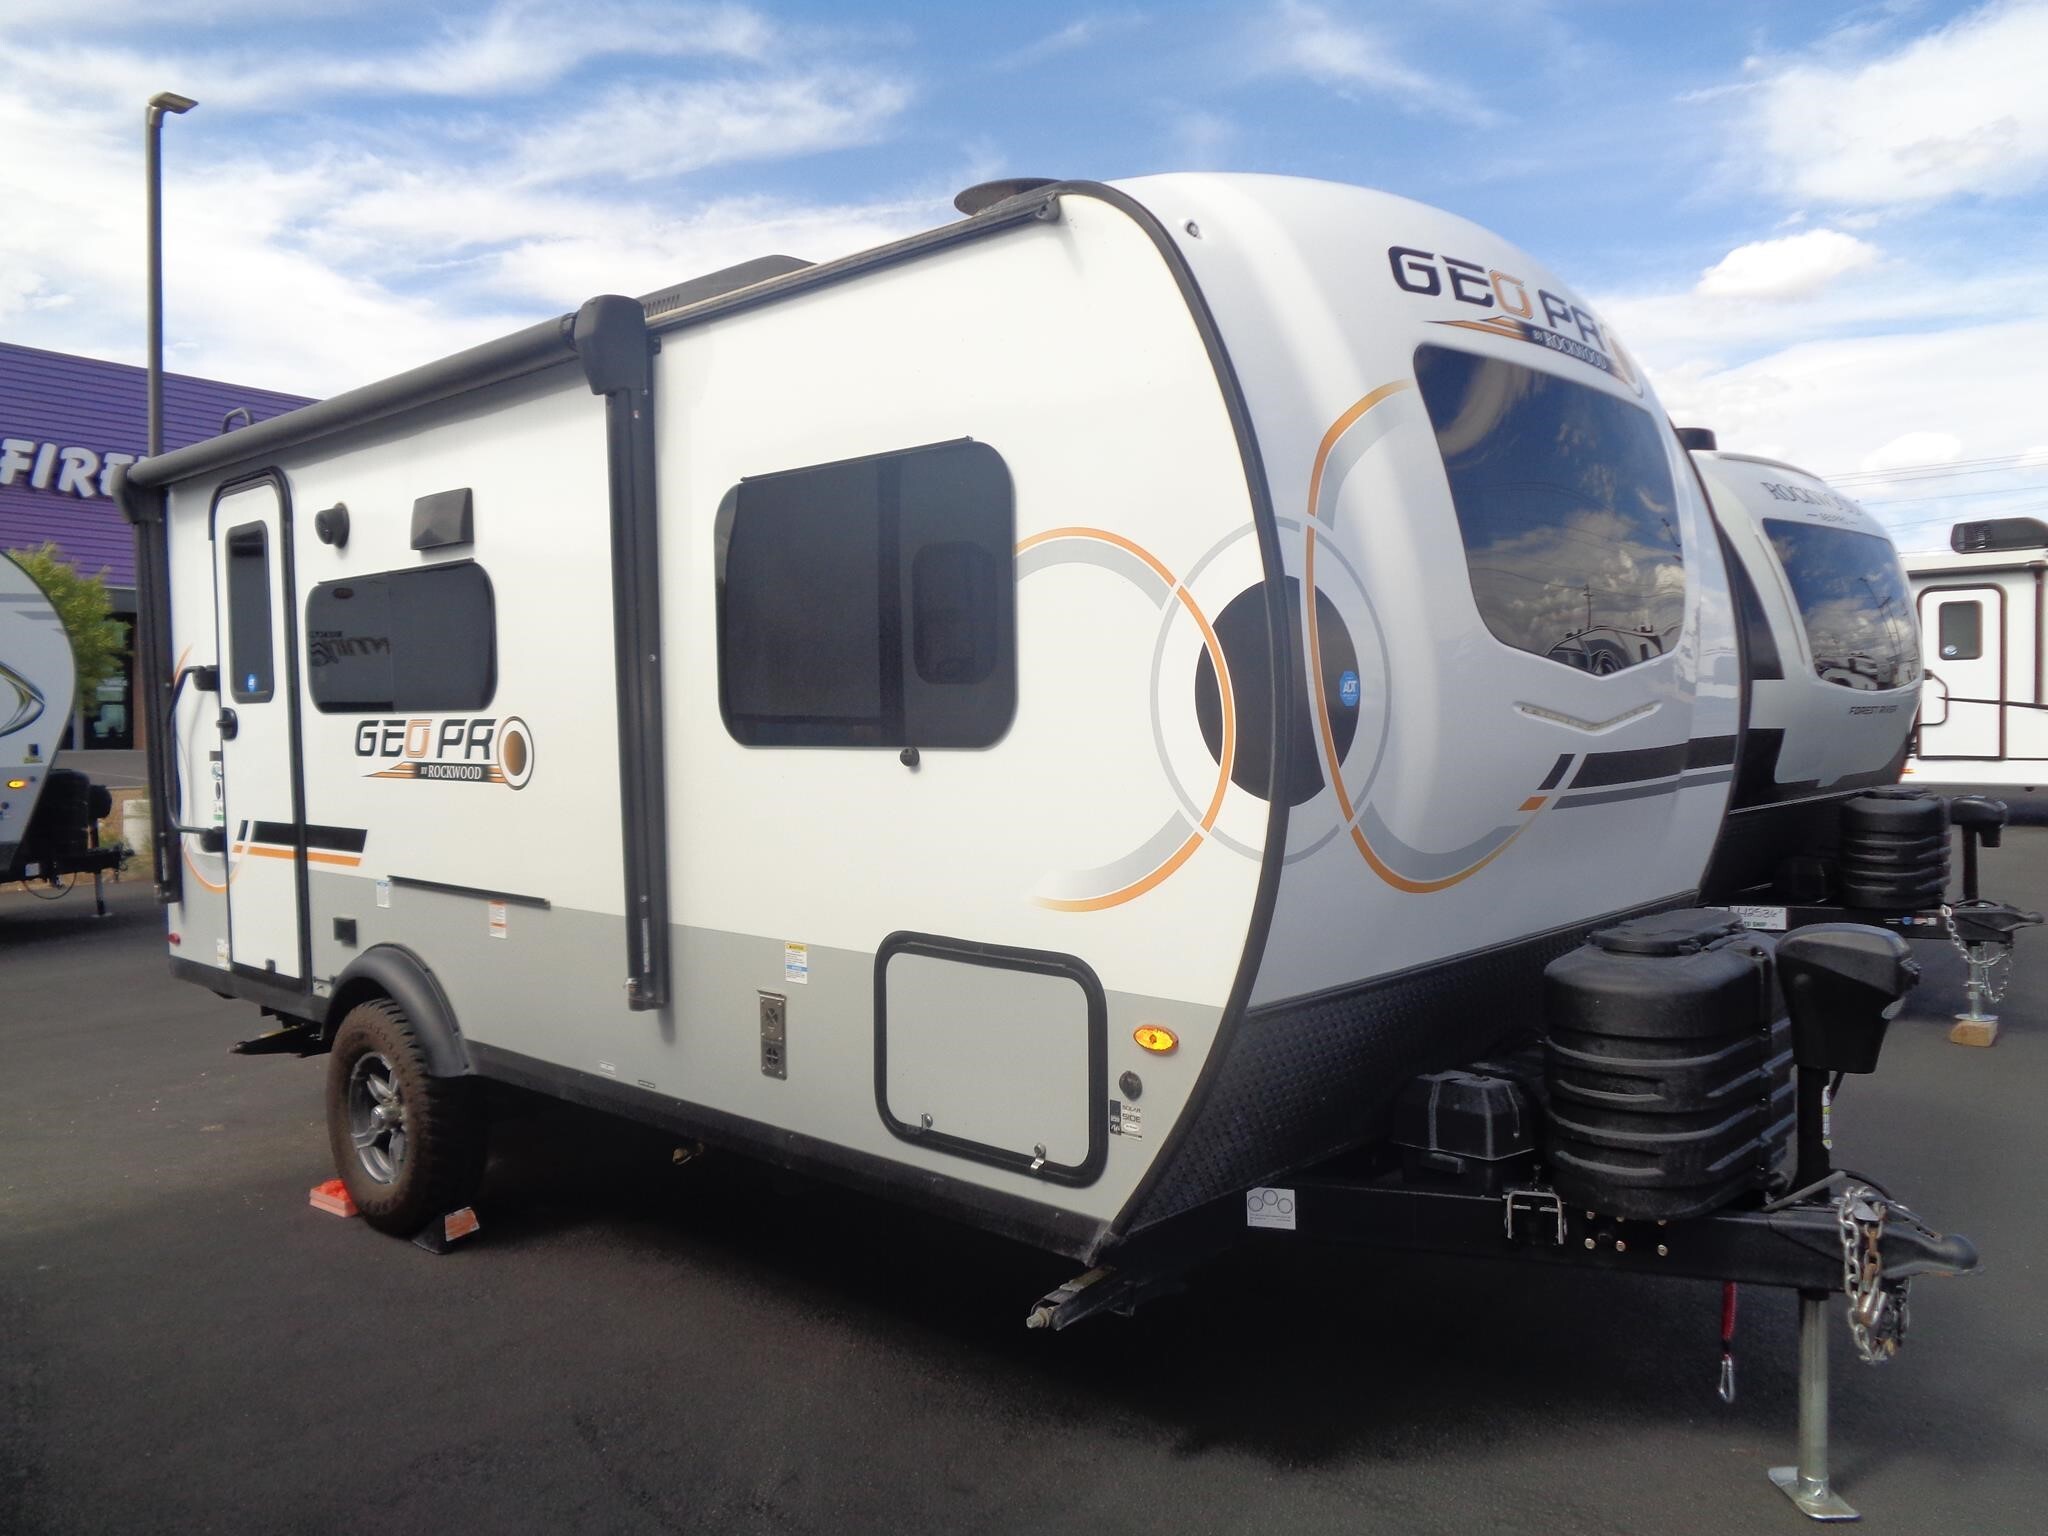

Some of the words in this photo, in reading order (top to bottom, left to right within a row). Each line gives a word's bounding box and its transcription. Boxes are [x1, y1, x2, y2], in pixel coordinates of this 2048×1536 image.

[1388, 246, 1533, 320] GEO
[1543, 331, 1607, 370] ROCKWOOD
[0, 438, 144, 498] FIRE
[354, 718, 433, 759] GEO
[428, 765, 482, 780] ROCKWOOD
[1122, 1113, 1141, 1123] SIDE
